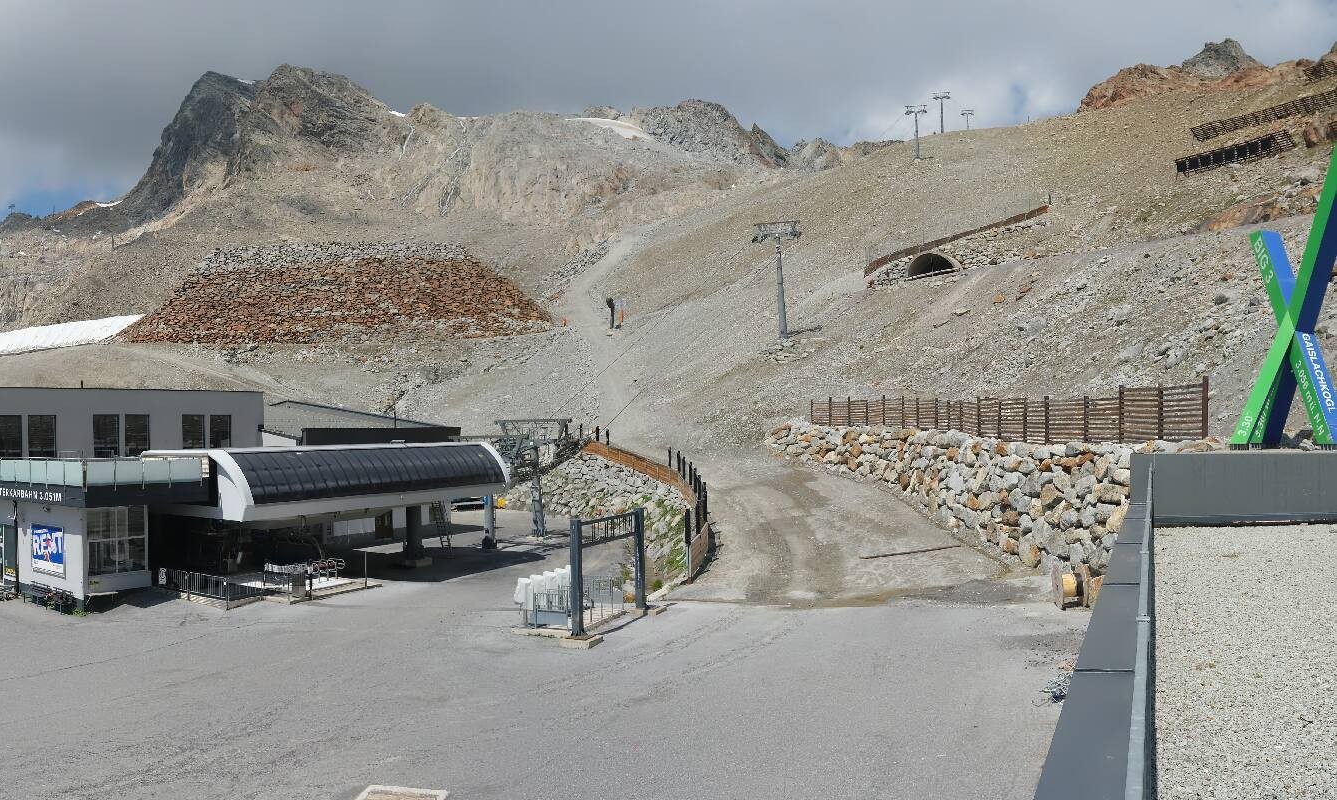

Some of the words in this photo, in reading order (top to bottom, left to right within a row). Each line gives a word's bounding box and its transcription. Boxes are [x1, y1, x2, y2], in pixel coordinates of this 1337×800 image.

[1254, 235, 1268, 270] BIG
[1265, 270, 1274, 284] 3
[1302, 333, 1336, 413] GAISLACHKOGL
[32, 532, 63, 556] RENT
